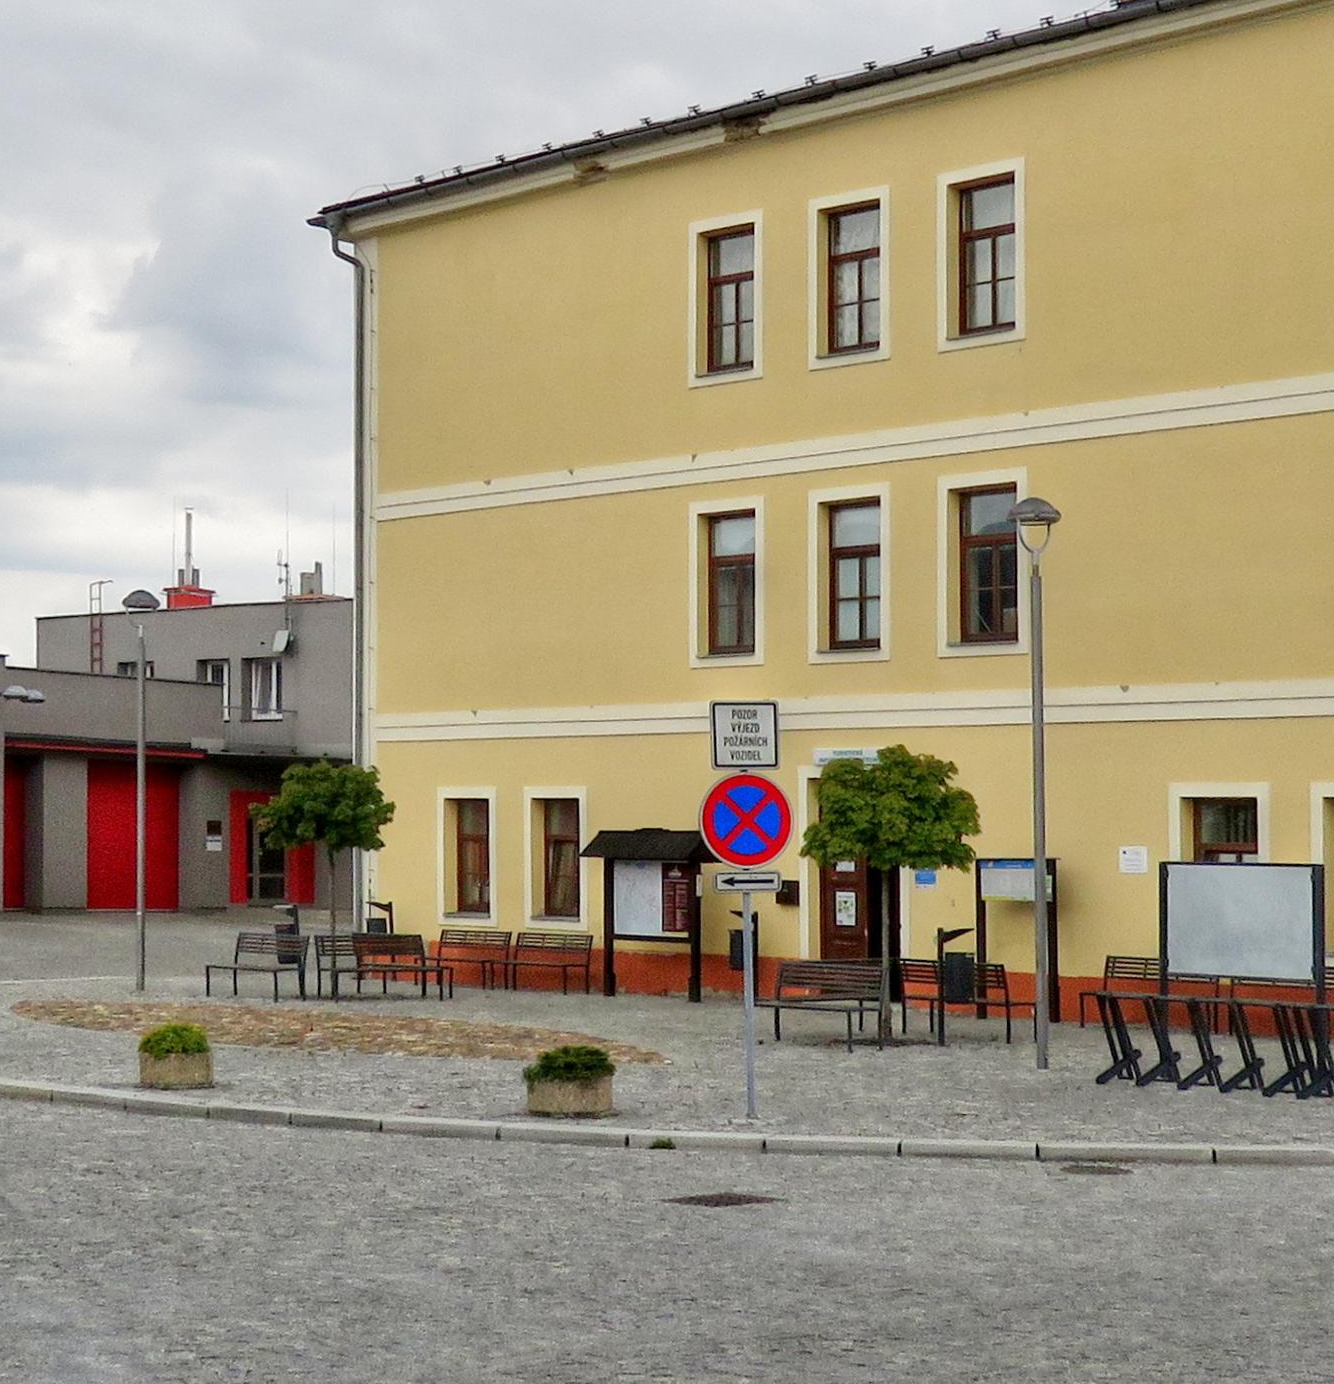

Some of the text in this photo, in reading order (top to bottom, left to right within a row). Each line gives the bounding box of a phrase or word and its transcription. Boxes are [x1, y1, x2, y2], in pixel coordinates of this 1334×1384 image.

[731, 709, 758, 720] POZOR
[730, 721, 760, 733] VÝJEZD
[729, 750, 762, 761] VOZIDEL
